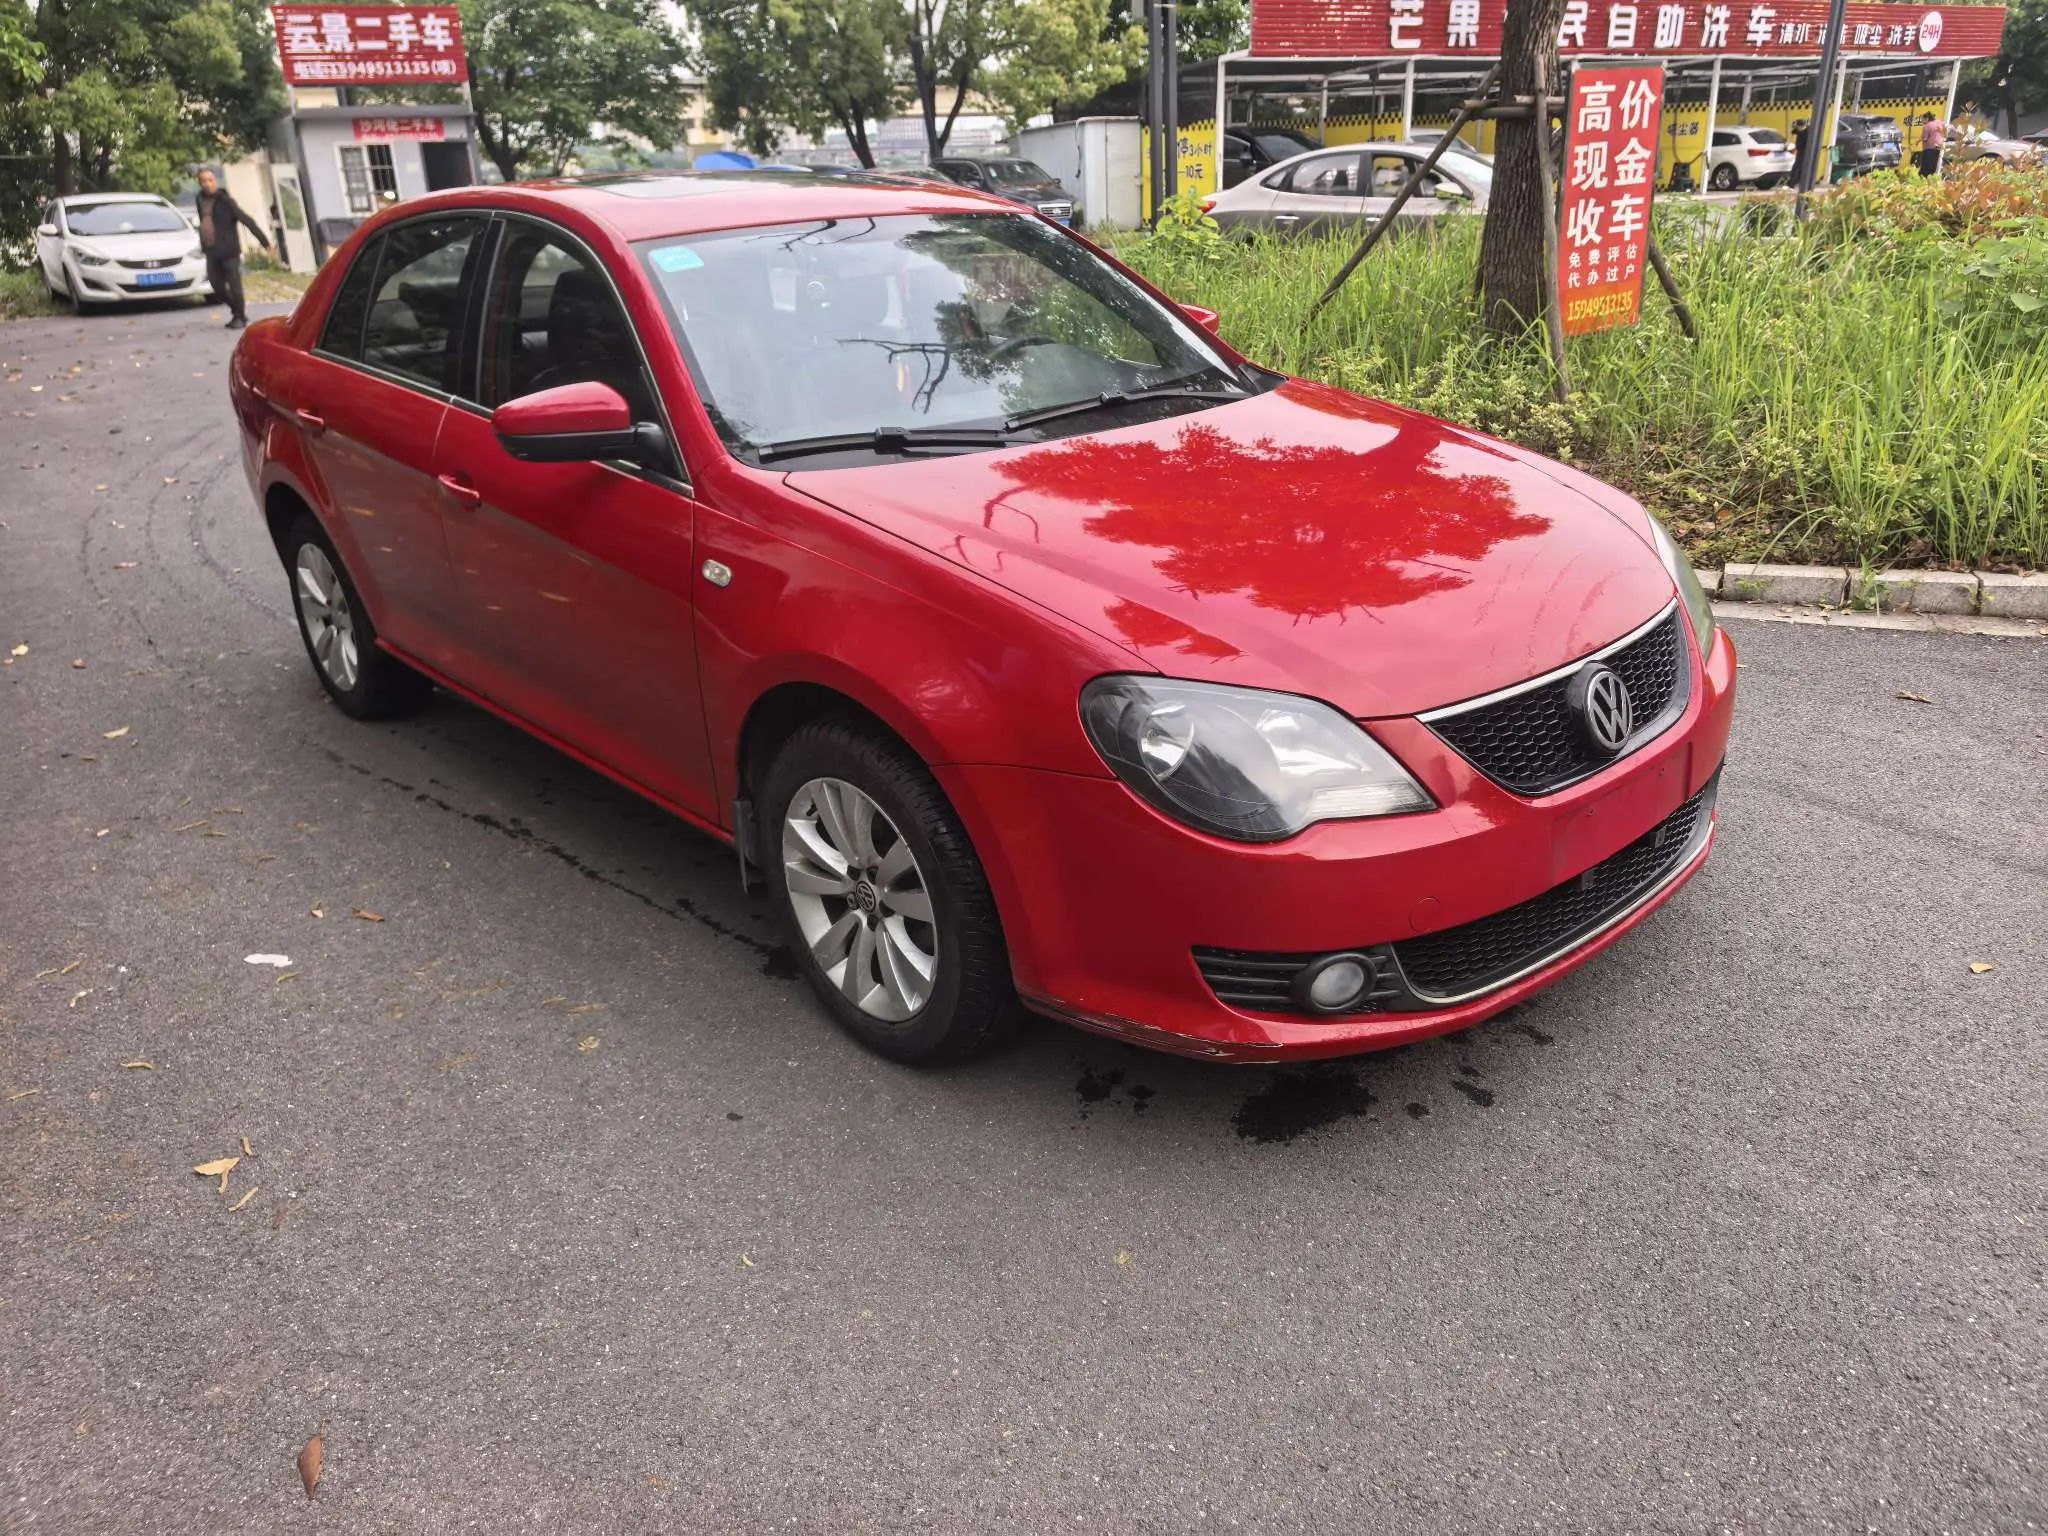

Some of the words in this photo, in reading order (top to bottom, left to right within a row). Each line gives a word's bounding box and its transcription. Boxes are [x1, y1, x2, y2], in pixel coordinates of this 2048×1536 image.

[284, 13, 453, 53] 云景二手车
[1389, 0, 1776, 48] 芒果民自助洗车
[1921, 24, 1940, 40] 24H
[1578, 79, 1657, 133] 高价
[1571, 137, 1652, 191] 现金
[1567, 193, 1645, 247] 收车
[1568, 243, 1638, 269] 免费评估
[1568, 263, 1636, 289] 代办过户
[1568, 291, 1633, 321] 15949513135
